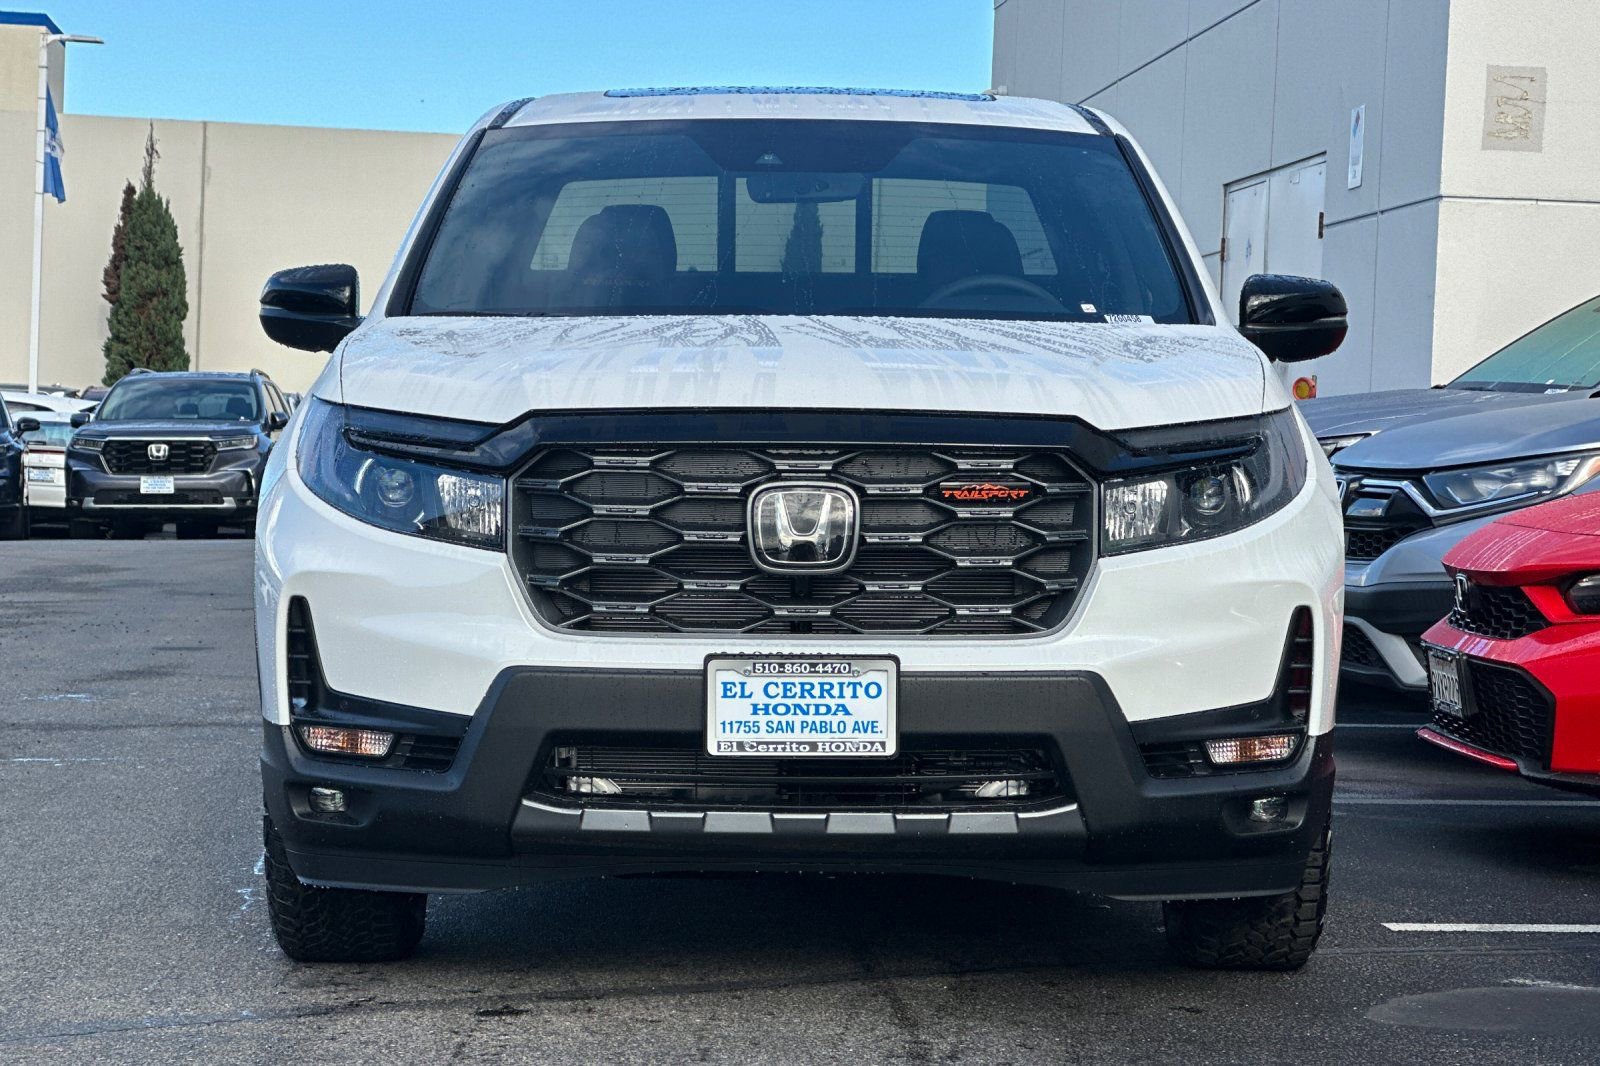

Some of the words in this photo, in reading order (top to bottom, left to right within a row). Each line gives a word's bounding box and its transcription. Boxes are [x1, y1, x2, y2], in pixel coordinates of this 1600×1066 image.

[942, 490, 1029, 500] TRAILSPORT
[754, 663, 850, 674] 510-860-4470
[720, 681, 754, 699] EL
[763, 681, 883, 700] CERRITO
[750, 703, 853, 716] HONDA
[720, 720, 761, 734] 11755
[765, 720, 795, 734] SAN
[800, 720, 847, 734] PABLO
[852, 720, 883, 734] AVE.
[719, 741, 738, 753] El
[744, 741, 810, 753] Cerrito
[817, 741, 884, 753] HONDA
